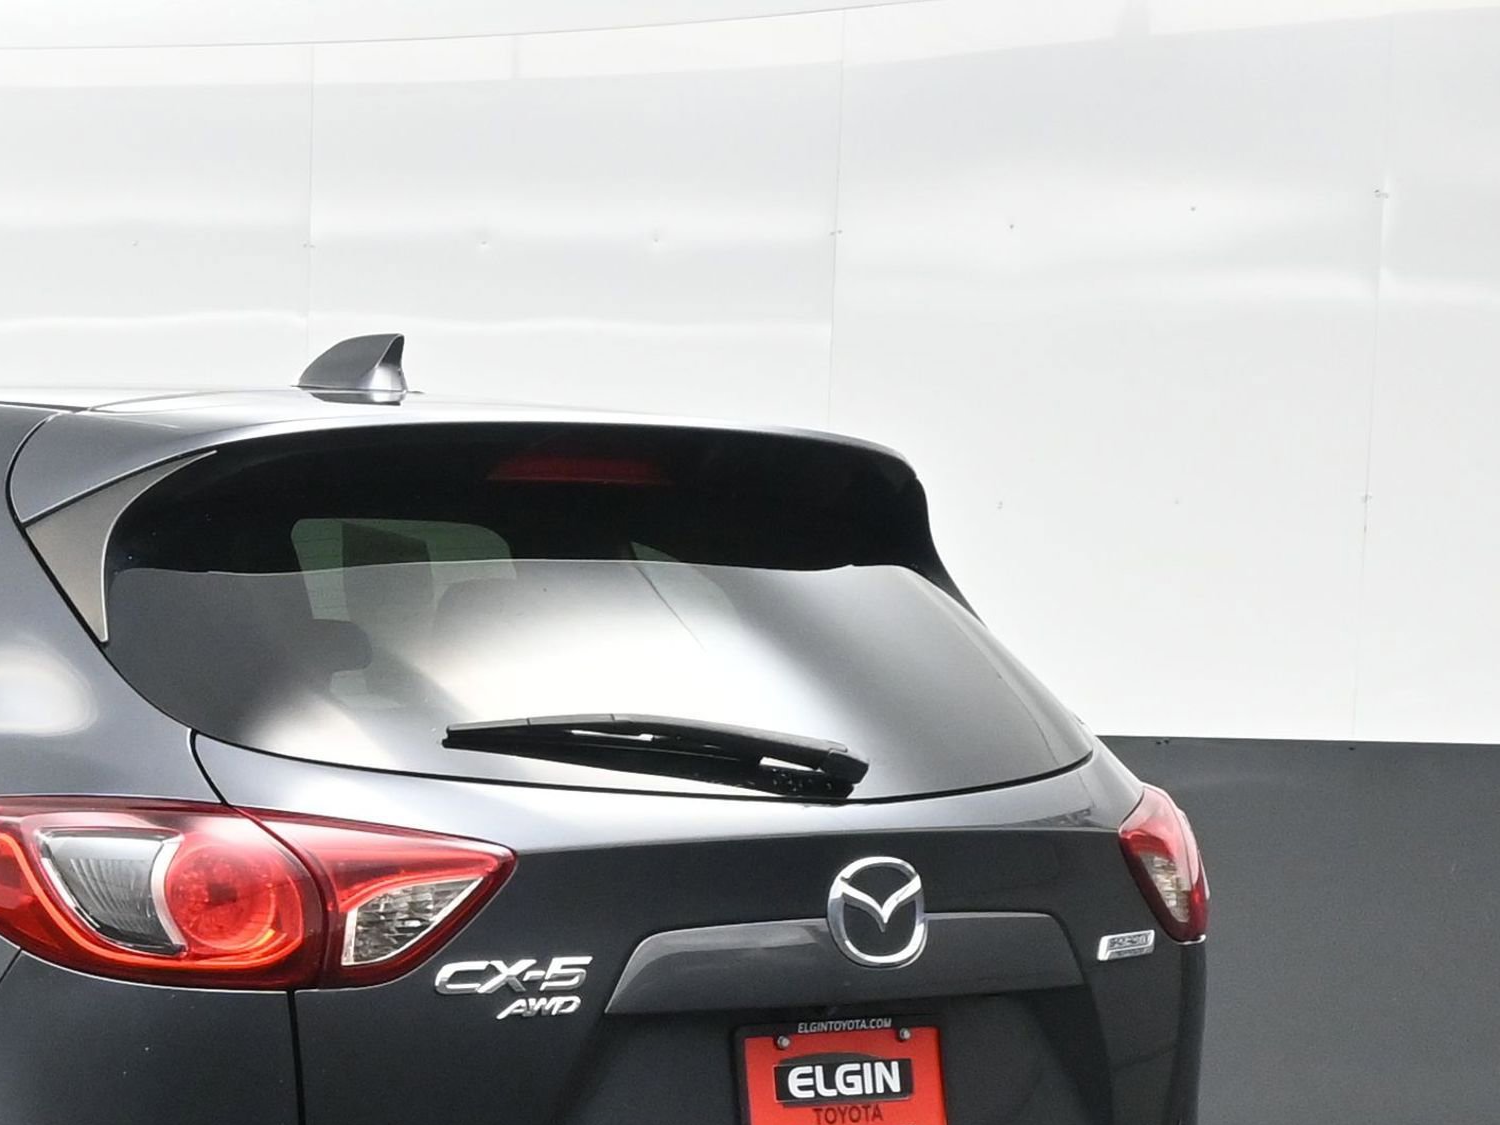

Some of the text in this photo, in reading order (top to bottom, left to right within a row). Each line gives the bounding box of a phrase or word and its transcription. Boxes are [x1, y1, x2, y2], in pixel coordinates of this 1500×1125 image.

[434, 955, 594, 995] CX-5
[495, 995, 582, 1020] AWD
[798, 1018, 892, 1034] ELGINTOYOTA.COM
[788, 1061, 901, 1098] ELGIN
[813, 1104, 883, 1125] TOYOTA
